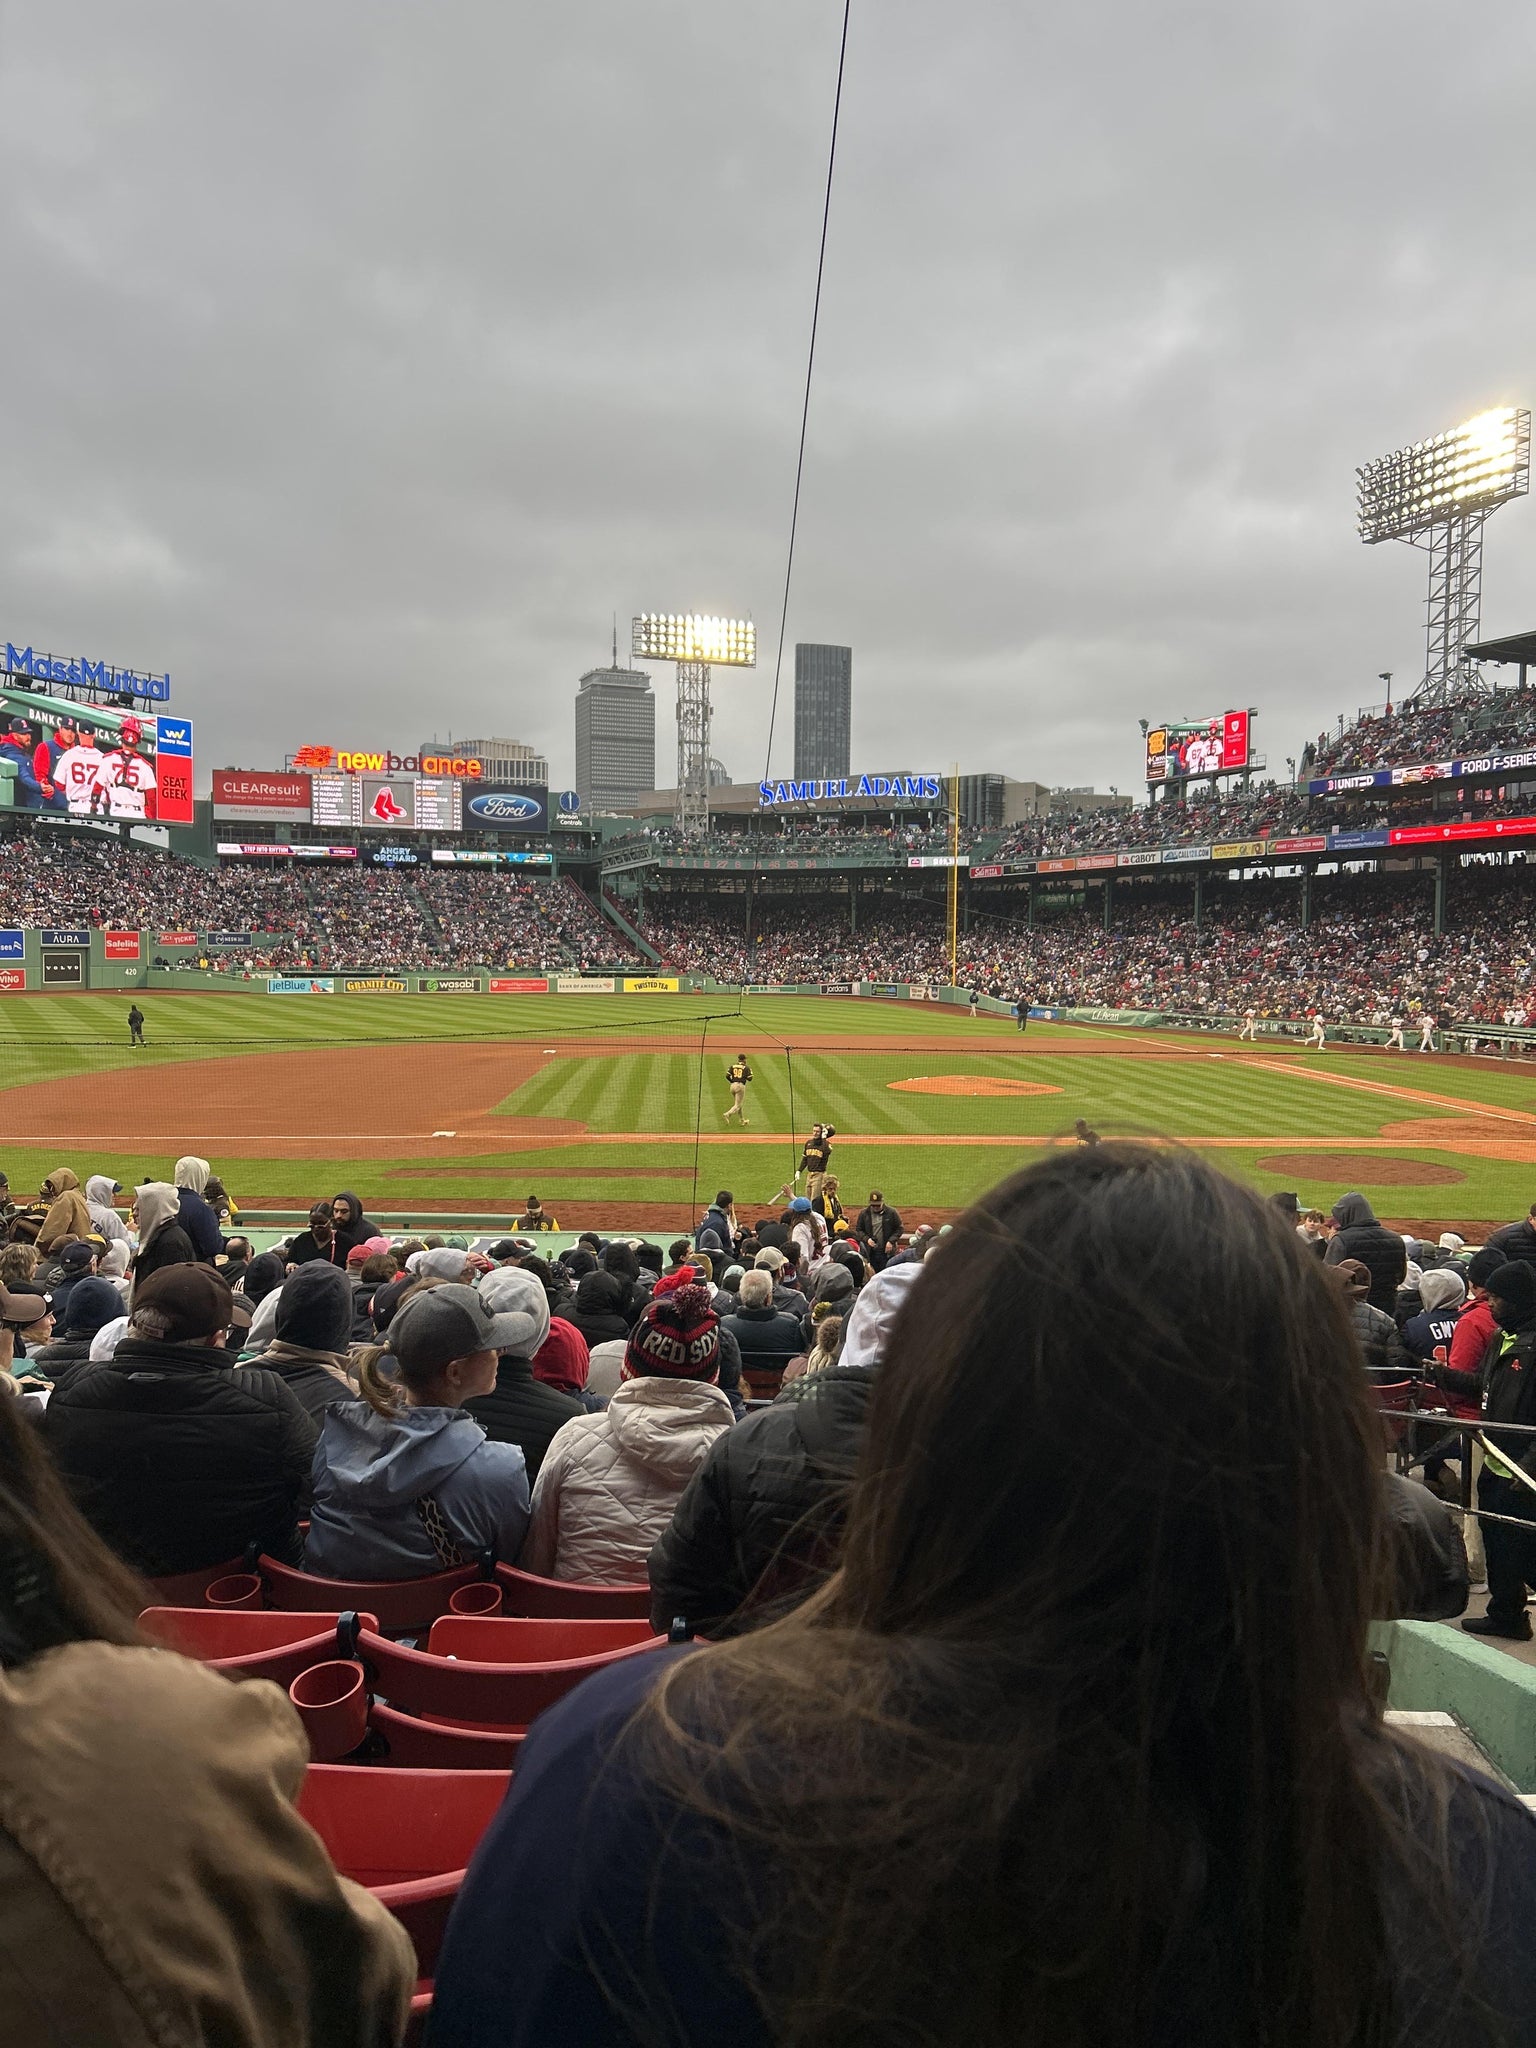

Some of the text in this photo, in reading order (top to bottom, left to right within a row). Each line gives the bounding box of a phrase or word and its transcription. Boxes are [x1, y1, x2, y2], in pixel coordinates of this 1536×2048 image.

[6, 642, 169, 701] MassMutual
[29, 709, 55, 726] BANK
[337, 750, 482, 775] new balance
[1461, 759, 1490, 774] FORD
[71, 762, 100, 785] 67
[163, 776, 187, 788] SEAT
[1338, 775, 1375, 789] UNITED
[223, 781, 301, 796] CLEAResult
[759, 774, 940, 807] SAMUEL ADAMS
[162, 789, 188, 801] GEEK
[483, 797, 527, 817] Ford
[556, 812, 579, 820] Johnson
[380, 847, 411, 855] ANGRY
[373, 853, 418, 862] ORCHARD
[106, 939, 138, 948] Safelite
[174, 935, 197, 944] TICKET
[125, 968, 137, 976] 420
[272, 980, 306, 991] jetBlue
[347, 980, 385, 991] GRANITE
[386, 979, 406, 991] CITY
[439, 979, 475, 988] wasabi
[633, 981, 669, 991] TWISTED TEA
[733, 1068, 743, 1078] 98
[642, 1330, 687, 1365] RED
